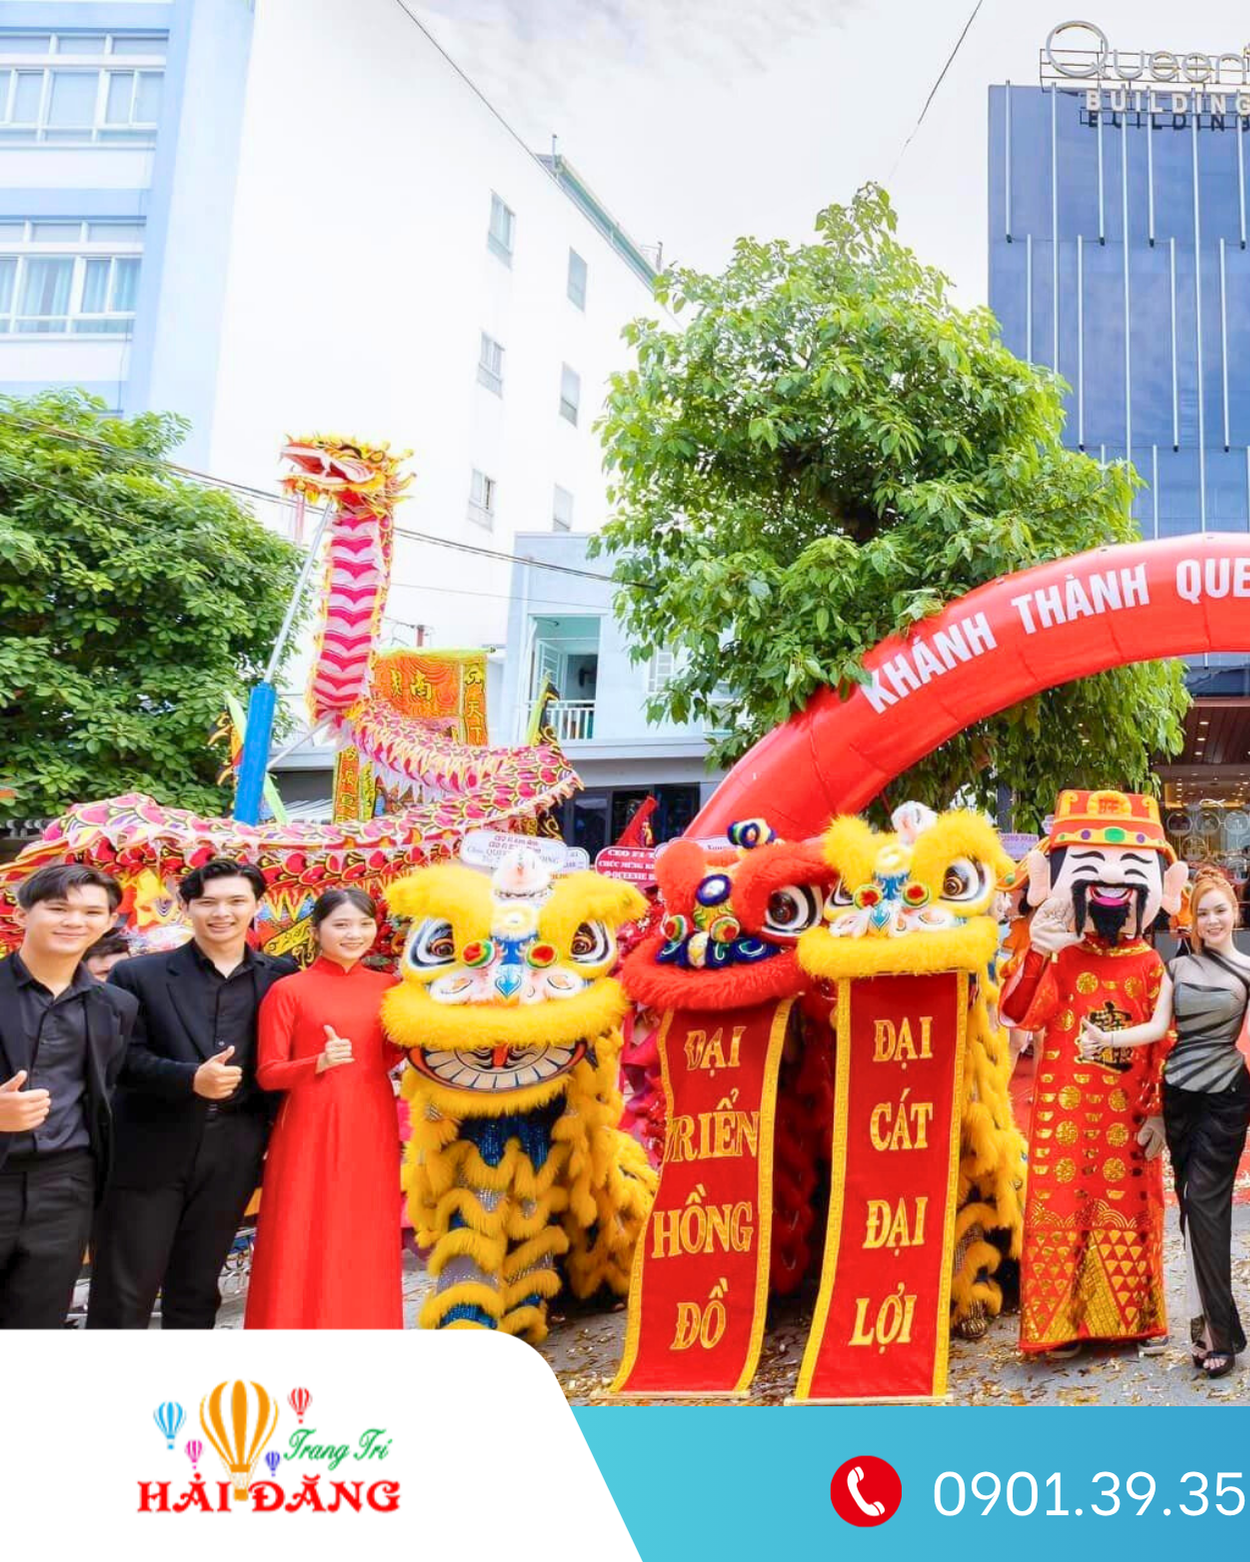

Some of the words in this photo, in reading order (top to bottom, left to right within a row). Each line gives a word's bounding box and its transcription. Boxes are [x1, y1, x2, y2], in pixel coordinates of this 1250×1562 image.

[860, 612, 997, 714] KHÁNH
[1011, 561, 1150, 634] THÀNH
[684, 1026, 746, 1077] ĐẠI
[873, 1016, 933, 1069] ĐẠI
[869, 1088, 933, 1151] CÁT
[651, 1184, 753, 1258] HỒNG
[862, 1197, 928, 1256] ĐẠI
[670, 1278, 728, 1349] ĐỒ
[848, 1282, 918, 1354] LỢI
